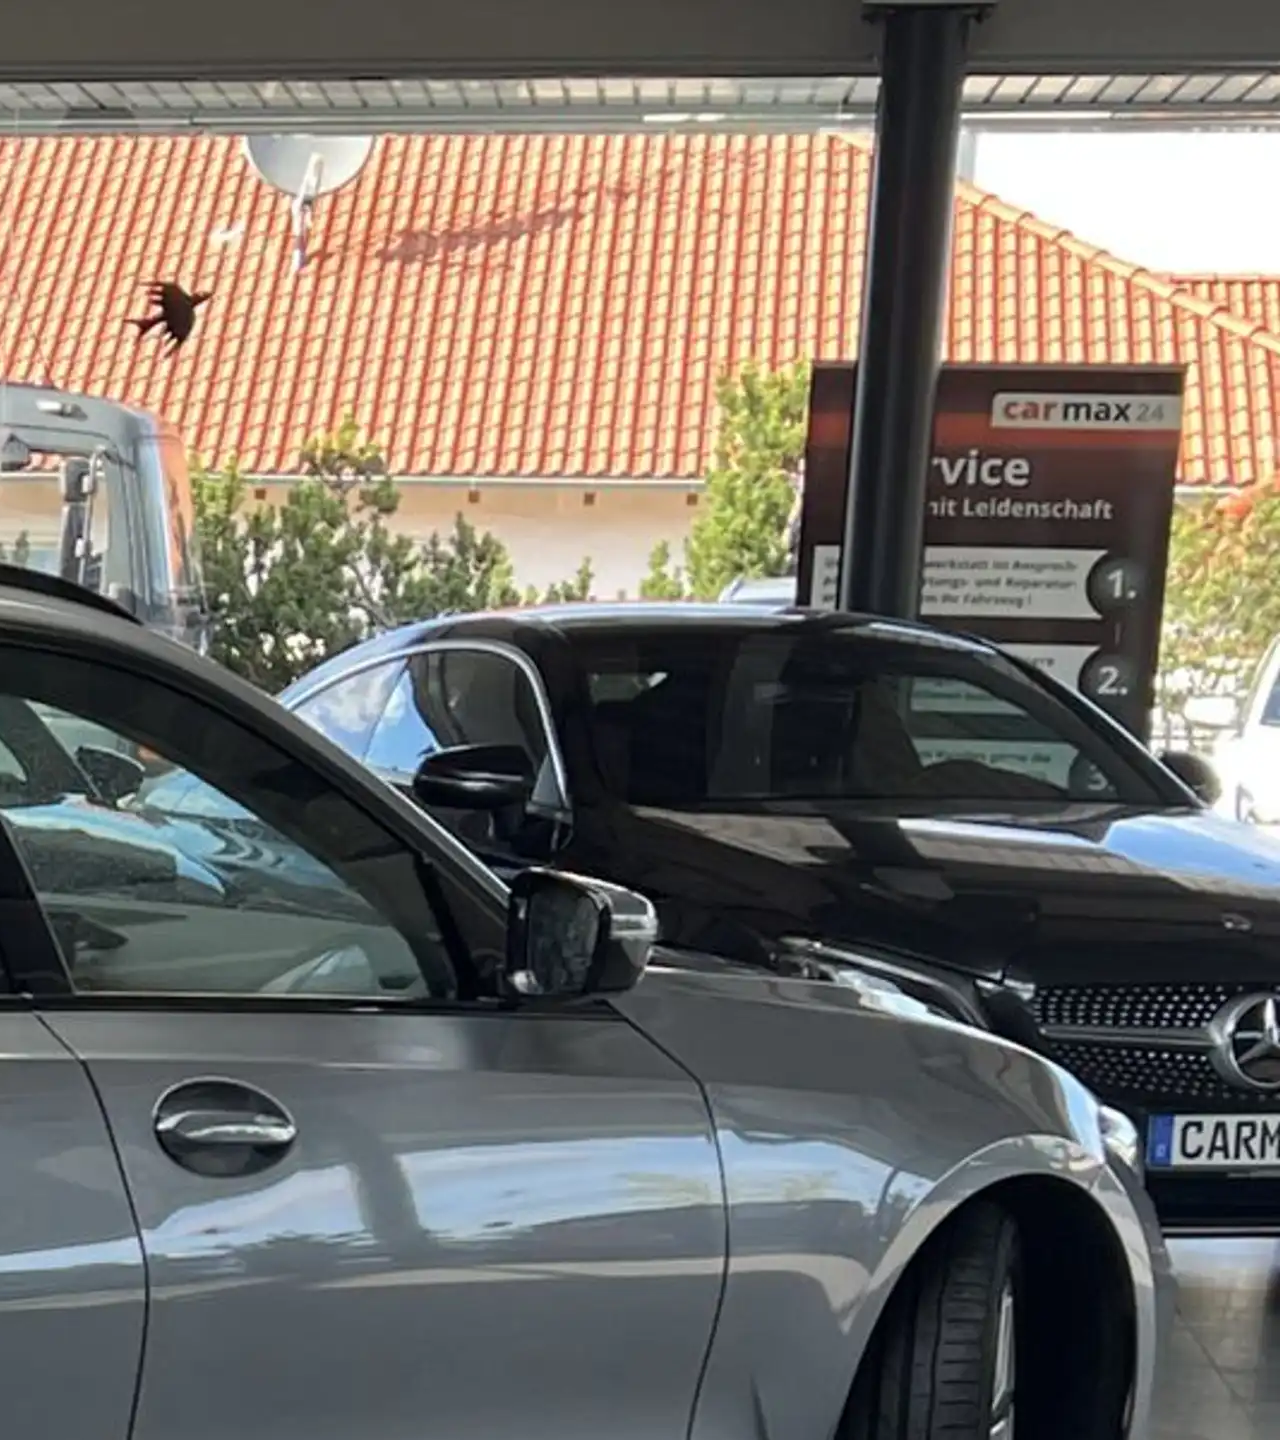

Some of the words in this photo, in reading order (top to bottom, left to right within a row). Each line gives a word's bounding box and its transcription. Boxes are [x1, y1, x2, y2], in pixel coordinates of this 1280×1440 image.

[931, 448, 1030, 487] vice
[962, 496, 1113, 520] Leidenschaft
[1107, 568, 1137, 600] 1.
[1097, 665, 1128, 696] 2.
